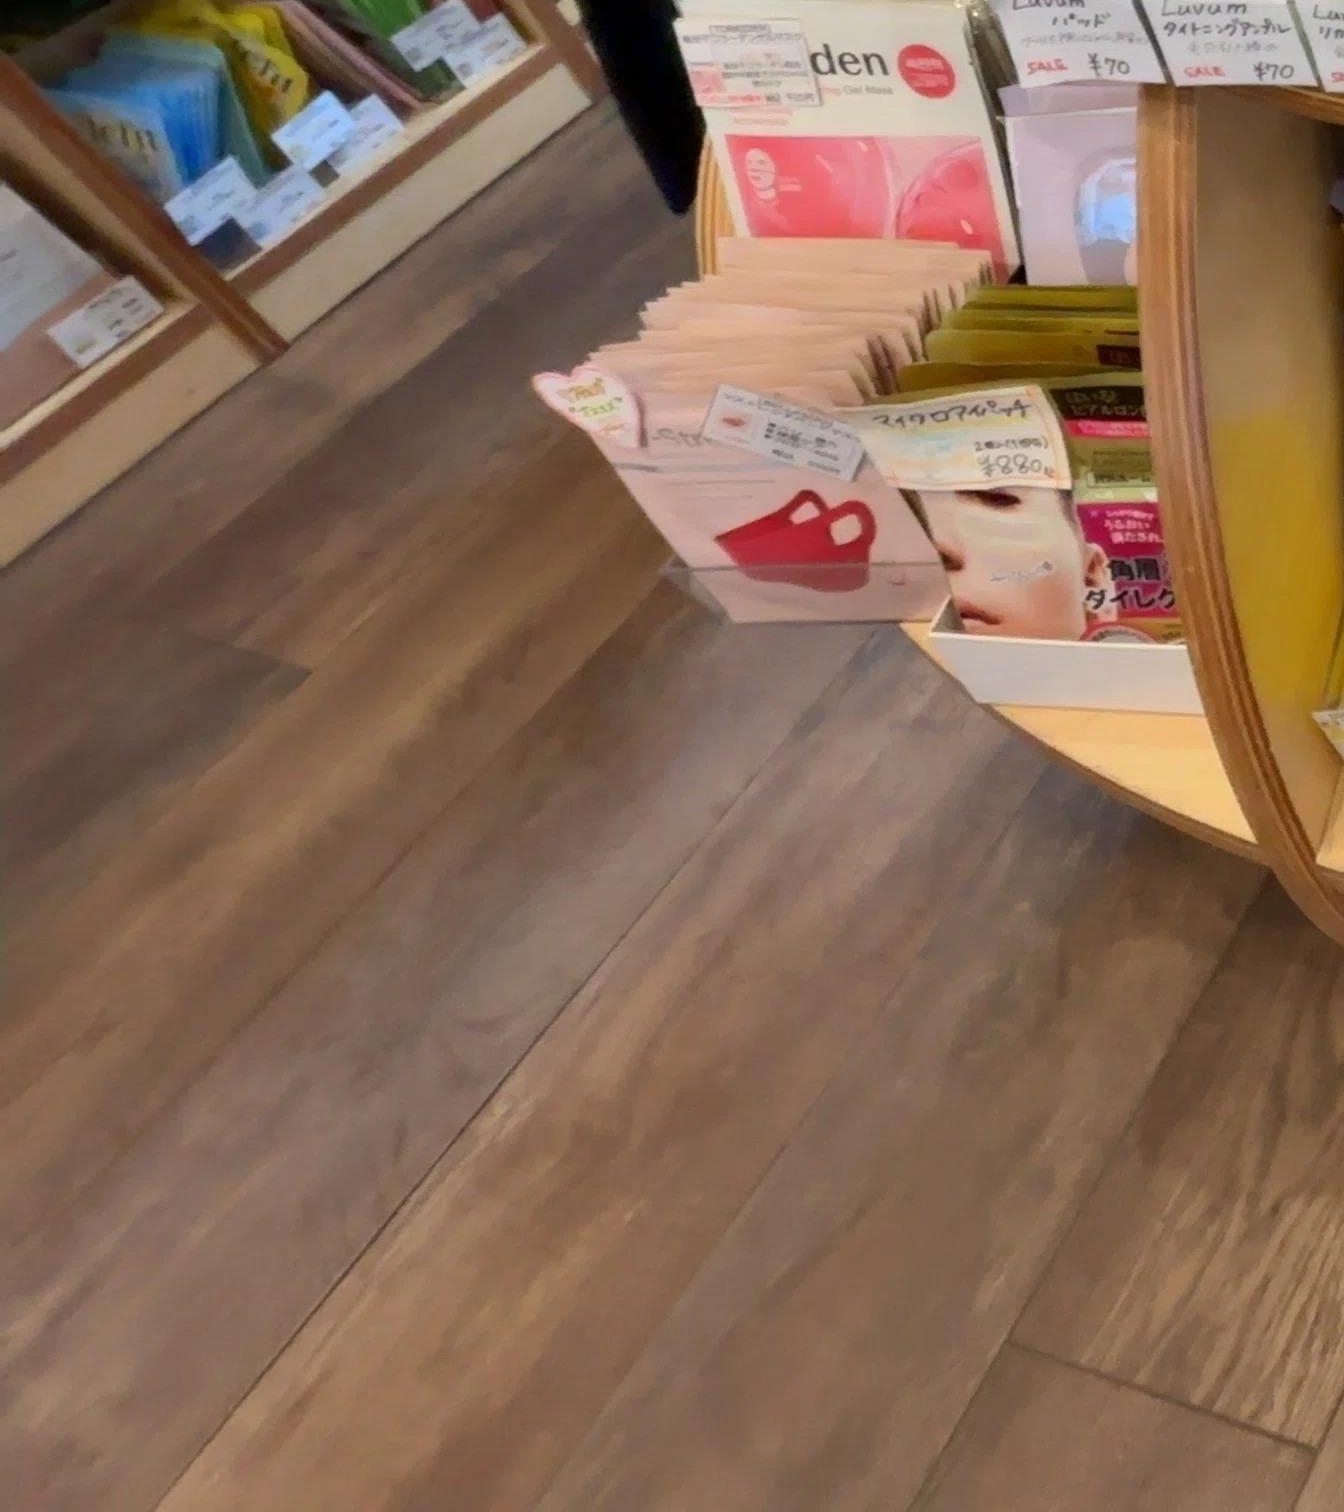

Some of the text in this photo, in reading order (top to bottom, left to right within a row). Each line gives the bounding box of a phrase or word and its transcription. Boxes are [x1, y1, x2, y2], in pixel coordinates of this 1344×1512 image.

[1160, 0, 1248, 16] Luvum
[1087, 54, 1131, 78] ¥70
[1253, 61, 1295, 81] ¥70
